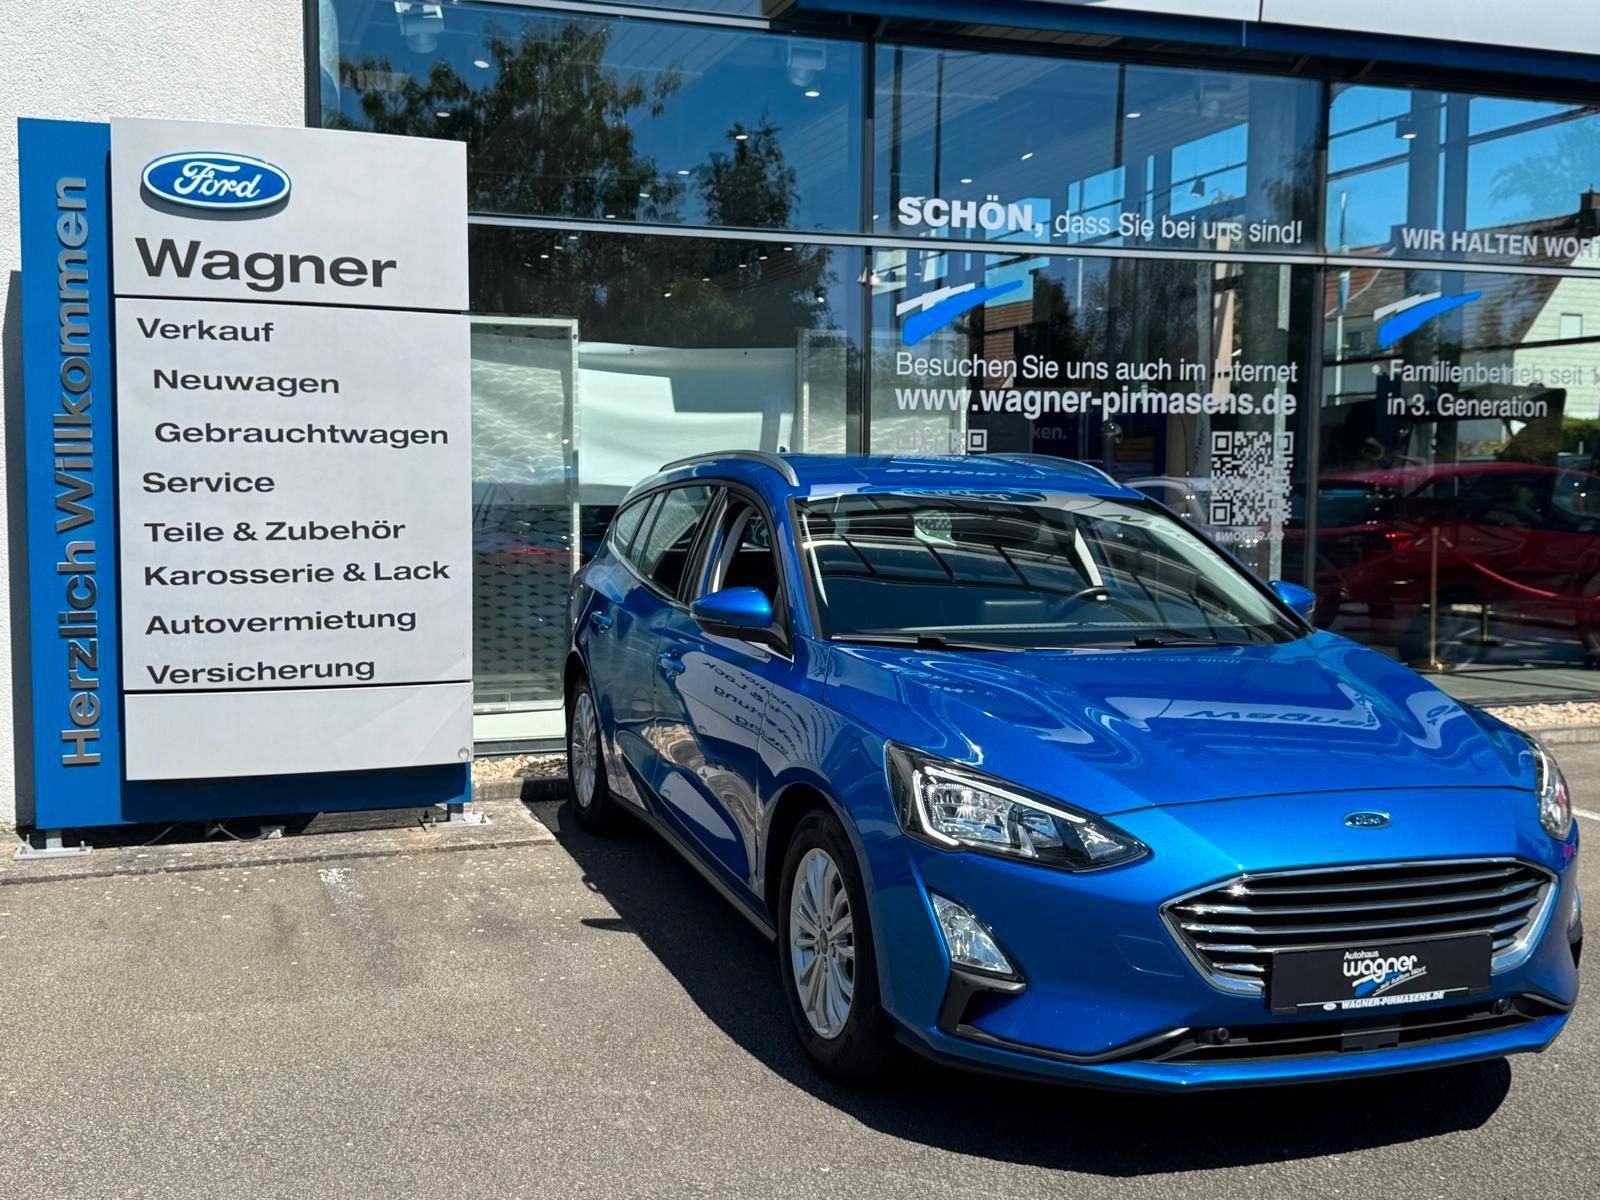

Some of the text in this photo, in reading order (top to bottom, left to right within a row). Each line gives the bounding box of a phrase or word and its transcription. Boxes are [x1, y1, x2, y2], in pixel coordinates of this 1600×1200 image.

[174, 161, 261, 199] Ford
[898, 195, 1303, 244] SCHÖN, dass Sie bei uns sind!
[1402, 228, 1445, 251] WIR
[1452, 231, 1538, 257] HALTEN
[135, 237, 397, 293] Wagner
[136, 317, 275, 343] Verkauf
[896, 352, 1017, 379] Besuchen
[1022, 354, 1059, 380] Sie
[1066, 361, 1107, 380] uns
[1116, 356, 1170, 381] auch
[1179, 358, 1206, 381] im
[1389, 359, 1544, 385] Familienbetrieb
[1550, 365, 1583, 386] seit
[153, 369, 340, 398] Neuwagen
[895, 385, 1298, 422] www.wagner-pirmasens.de
[1387, 393, 1548, 417] in 3. Generation
[154, 422, 449, 449] Gebrauchtwagen
[53, 177, 101, 767] Herzlich Willkommen
[142, 471, 276, 493] Service
[144, 520, 407, 543] Teile & Zubehör
[144, 561, 451, 587] Karosserie & Lack
[145, 610, 418, 636] Autovermietung
[147, 658, 376, 686] Versicherung
[1343, 955, 1417, 983] wagner
[1344, 950, 1379, 960] Autohaus
